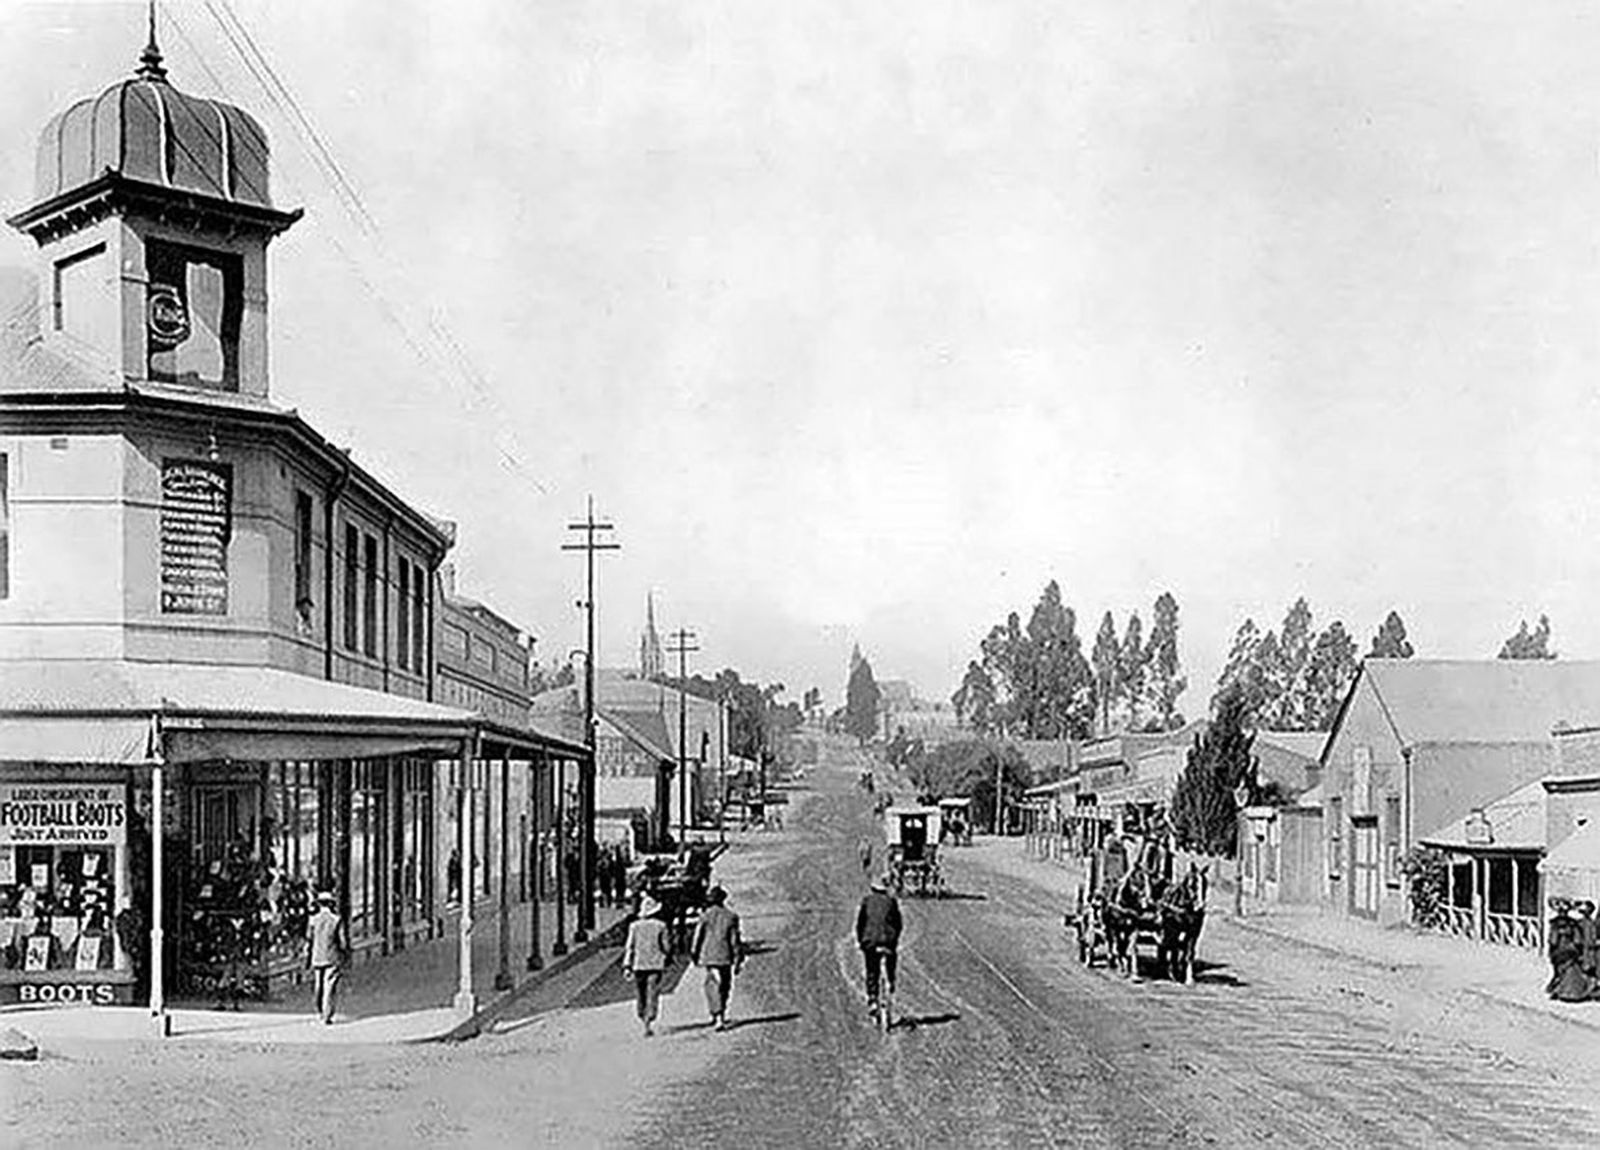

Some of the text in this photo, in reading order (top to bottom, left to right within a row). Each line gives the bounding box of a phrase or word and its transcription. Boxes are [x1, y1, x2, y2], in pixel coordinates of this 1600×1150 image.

[1, 800, 124, 826] FOOTBALL BOOTS
[10, 828, 45, 840] JUST
[20, 984, 114, 1004] BOOTS
